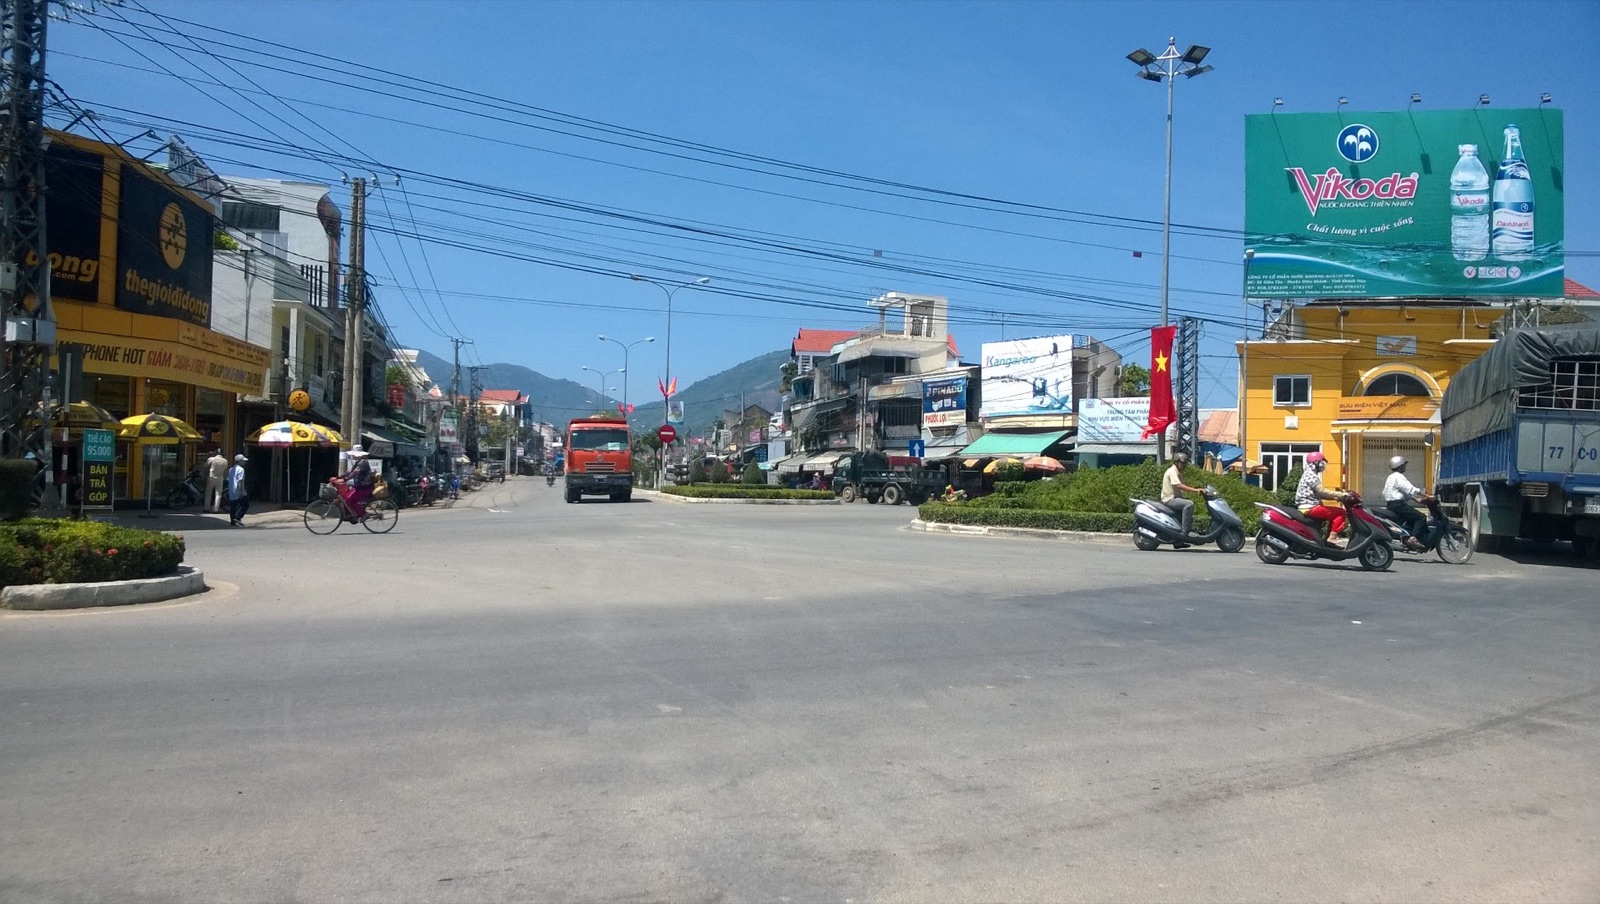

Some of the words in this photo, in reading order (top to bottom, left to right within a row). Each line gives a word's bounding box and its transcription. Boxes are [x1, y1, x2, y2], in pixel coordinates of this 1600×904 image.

[1284, 167, 1418, 217] Vikoda
[1306, 222, 1329, 233] Chất
[1331, 226, 1357, 236] lượng
[1370, 223, 1391, 233] cuộc
[1393, 216, 1414, 228] sống
[125, 268, 210, 324] thegioididong
[122, 347, 146, 365] HOT
[986, 355, 1036, 367] Kangaroo
[88, 446, 111, 456] 95.000
[1549, 447, 1564, 459] 77
[90, 464, 108, 474] BÁN
[90, 477, 106, 488] TRẢ
[89, 490, 107, 502] GÓP
